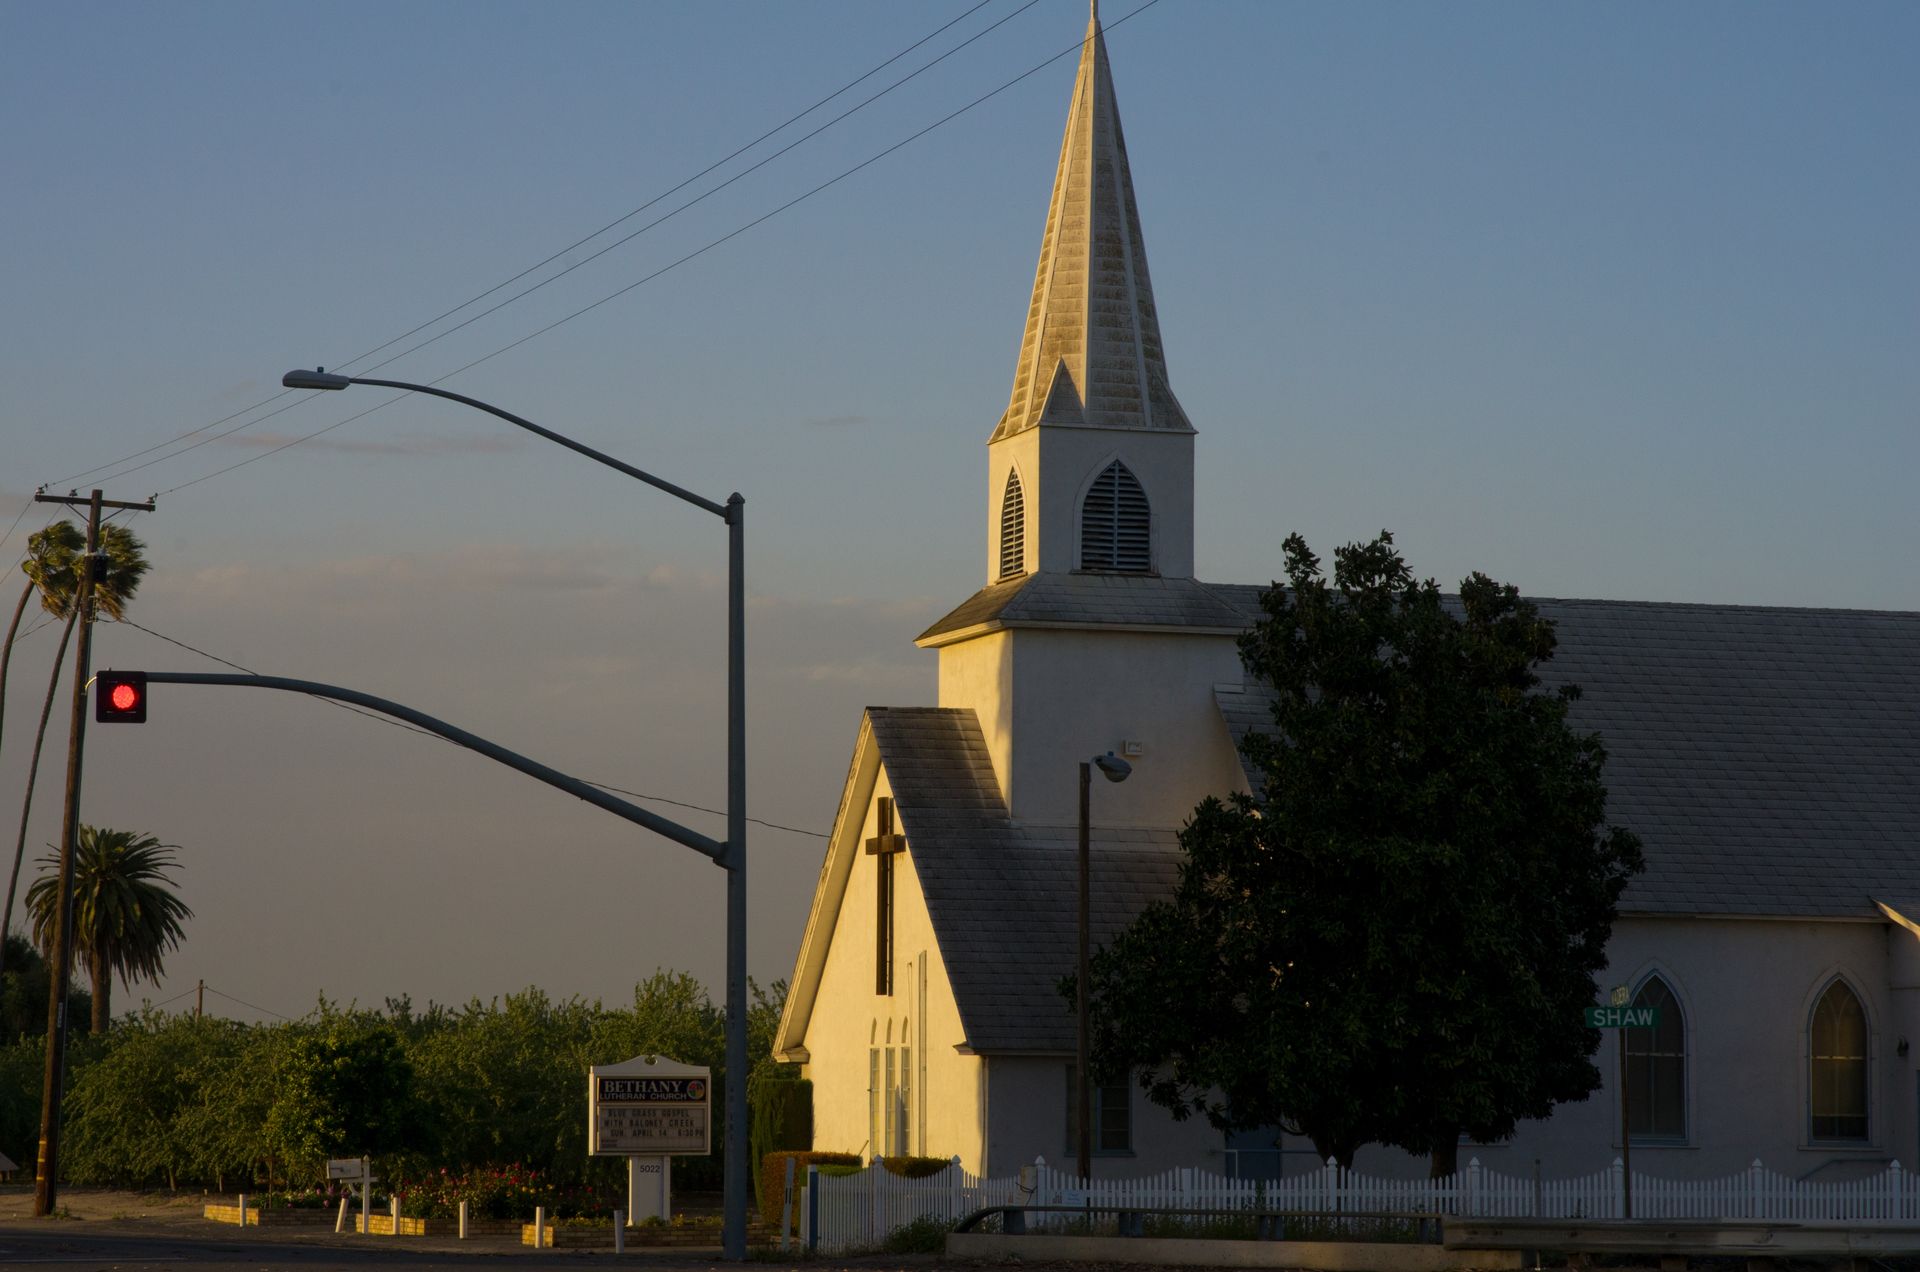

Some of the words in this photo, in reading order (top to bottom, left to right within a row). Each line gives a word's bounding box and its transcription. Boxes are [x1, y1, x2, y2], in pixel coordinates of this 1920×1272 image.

[1593, 1008, 1653, 1026] SHAW
[605, 1080, 683, 1093] BETHANY
[600, 1092, 646, 1101] LUTHERAN
[650, 1092, 687, 1101] CHURCH
[632, 1108, 656, 1117] GRASS
[604, 1119, 623, 1127] WITH
[669, 1119, 694, 1127] CREEK
[632, 1129, 653, 1137] APRIL
[639, 1165, 660, 1173] 5022
